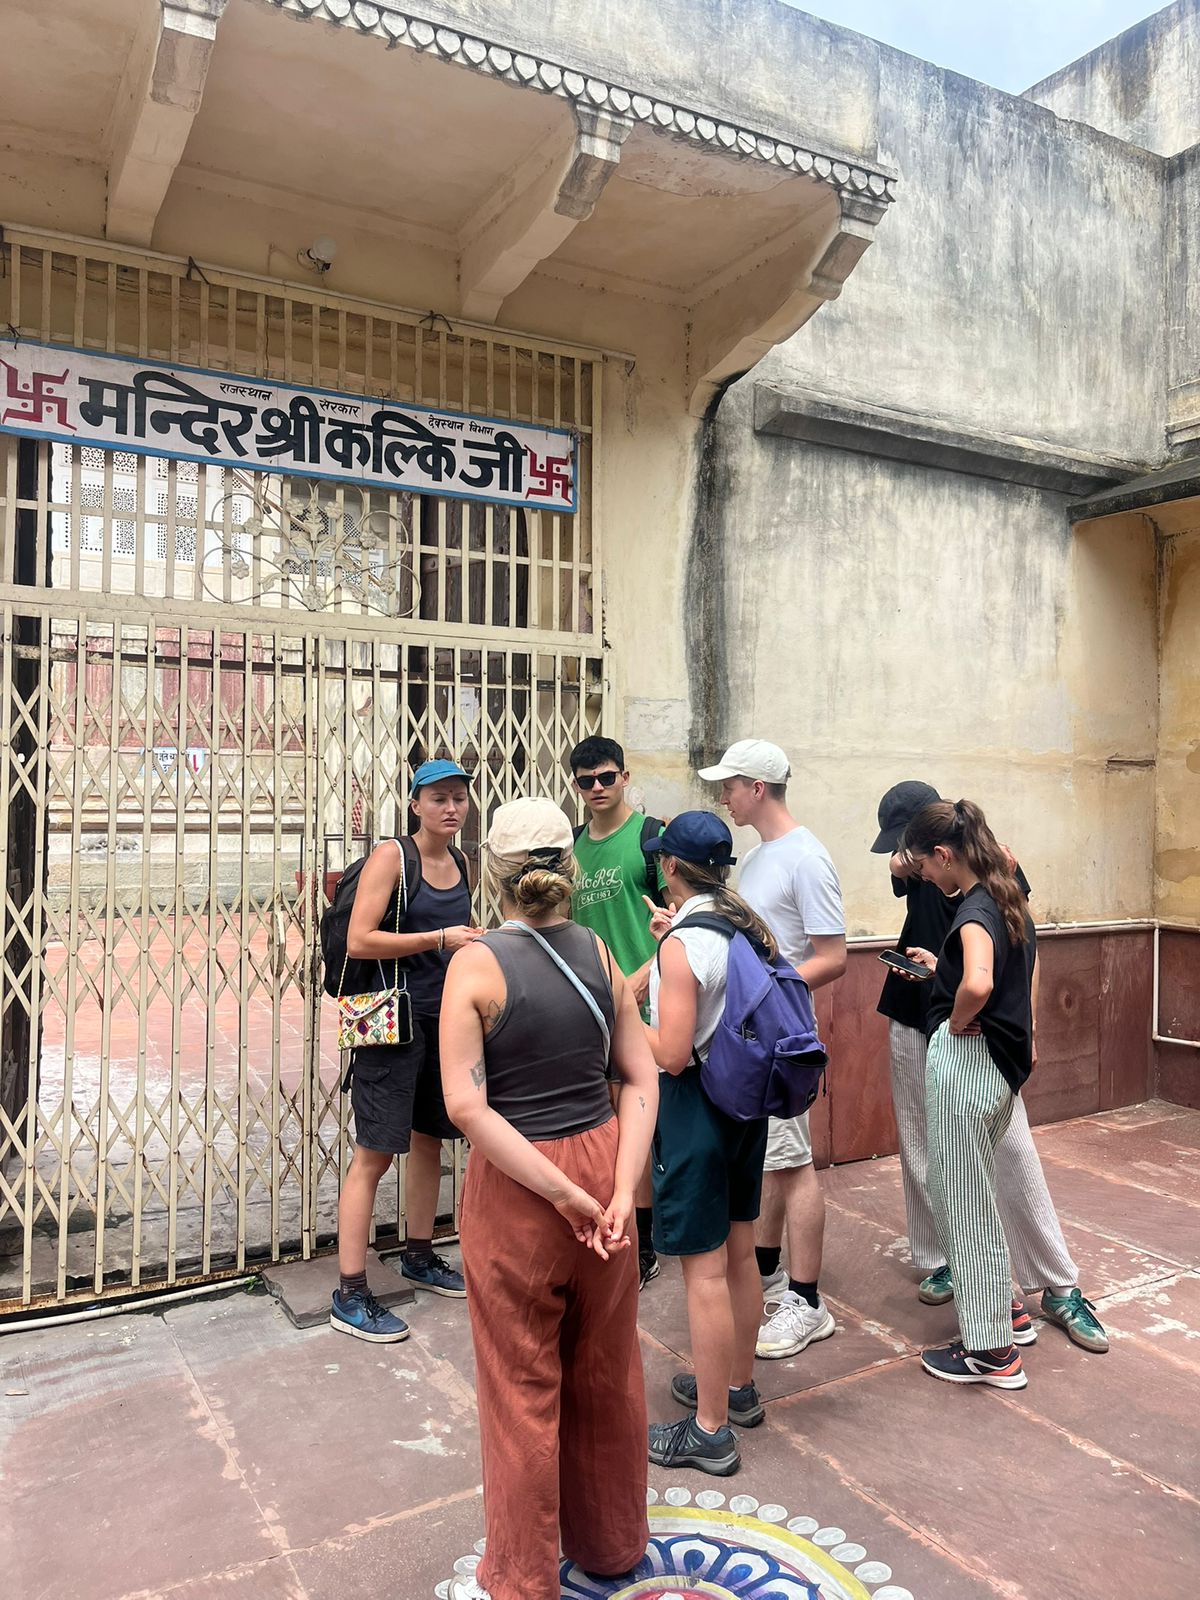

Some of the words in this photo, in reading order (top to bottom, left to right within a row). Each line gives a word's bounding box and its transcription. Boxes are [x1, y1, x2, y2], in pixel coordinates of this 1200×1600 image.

[79, 371, 257, 457] मन्दिर
[255, 396, 324, 465] श्री
[325, 410, 457, 482] कल्कि
[459, 431, 527, 493] जी
[219, 382, 273, 401] राजस्थान
[319, 398, 361, 418] सरकार
